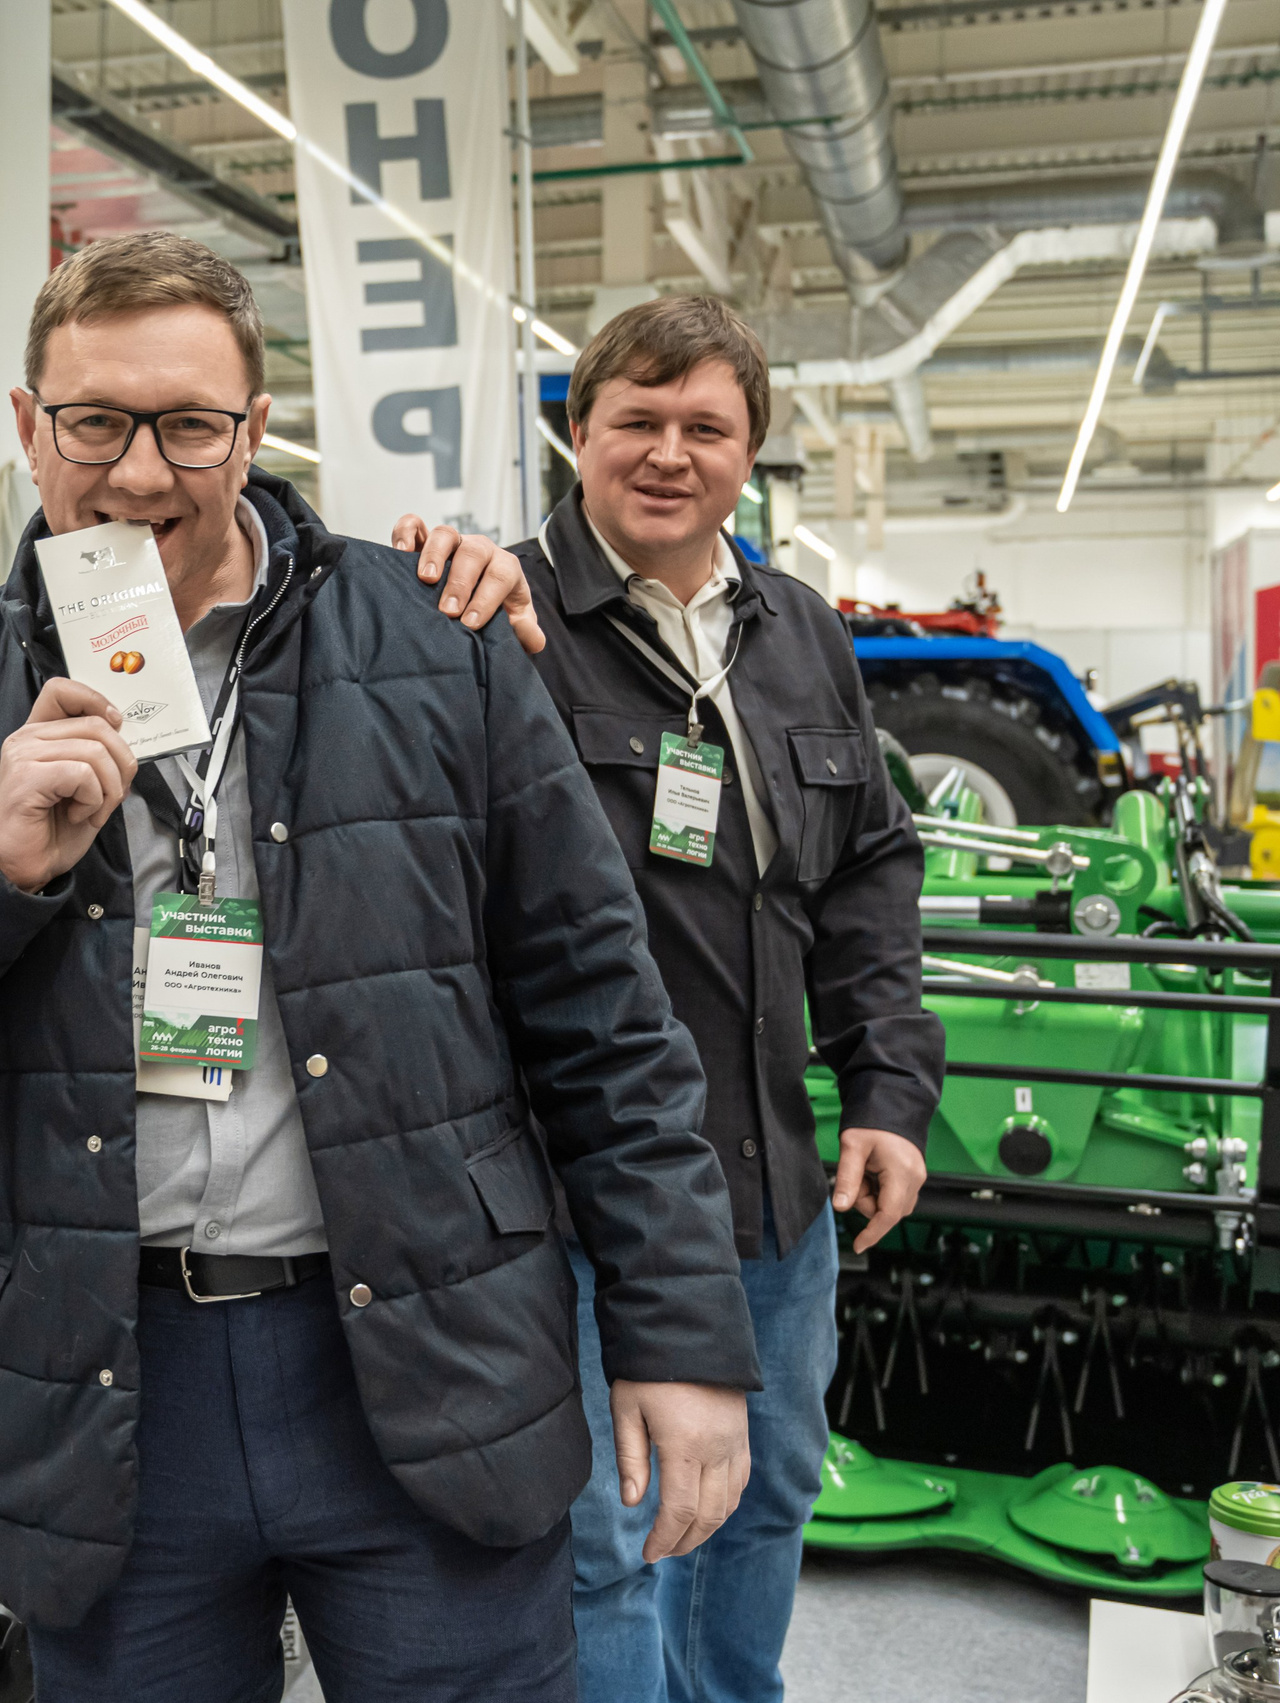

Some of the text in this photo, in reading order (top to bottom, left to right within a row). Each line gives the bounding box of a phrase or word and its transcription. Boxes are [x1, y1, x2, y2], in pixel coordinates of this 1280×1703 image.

[58, 601, 85, 616] THE
[91, 582, 164, 608] ORIGINAL
[91, 616, 148, 648] МОЛОЧНЫЙ
[127, 703, 156, 718] SAVOY
[666, 745, 702, 762] участник
[680, 759, 716, 774] выставки
[160, 910, 227, 923] участник
[185, 924, 252, 937] выставки
[189, 961, 221, 970] Иванов
[164, 968, 244, 981] Андрей Олегович
[184, 983, 242, 994] «Агротехника»
[207, 1036, 243, 1046] техно
[205, 1047, 243, 1058] логии
